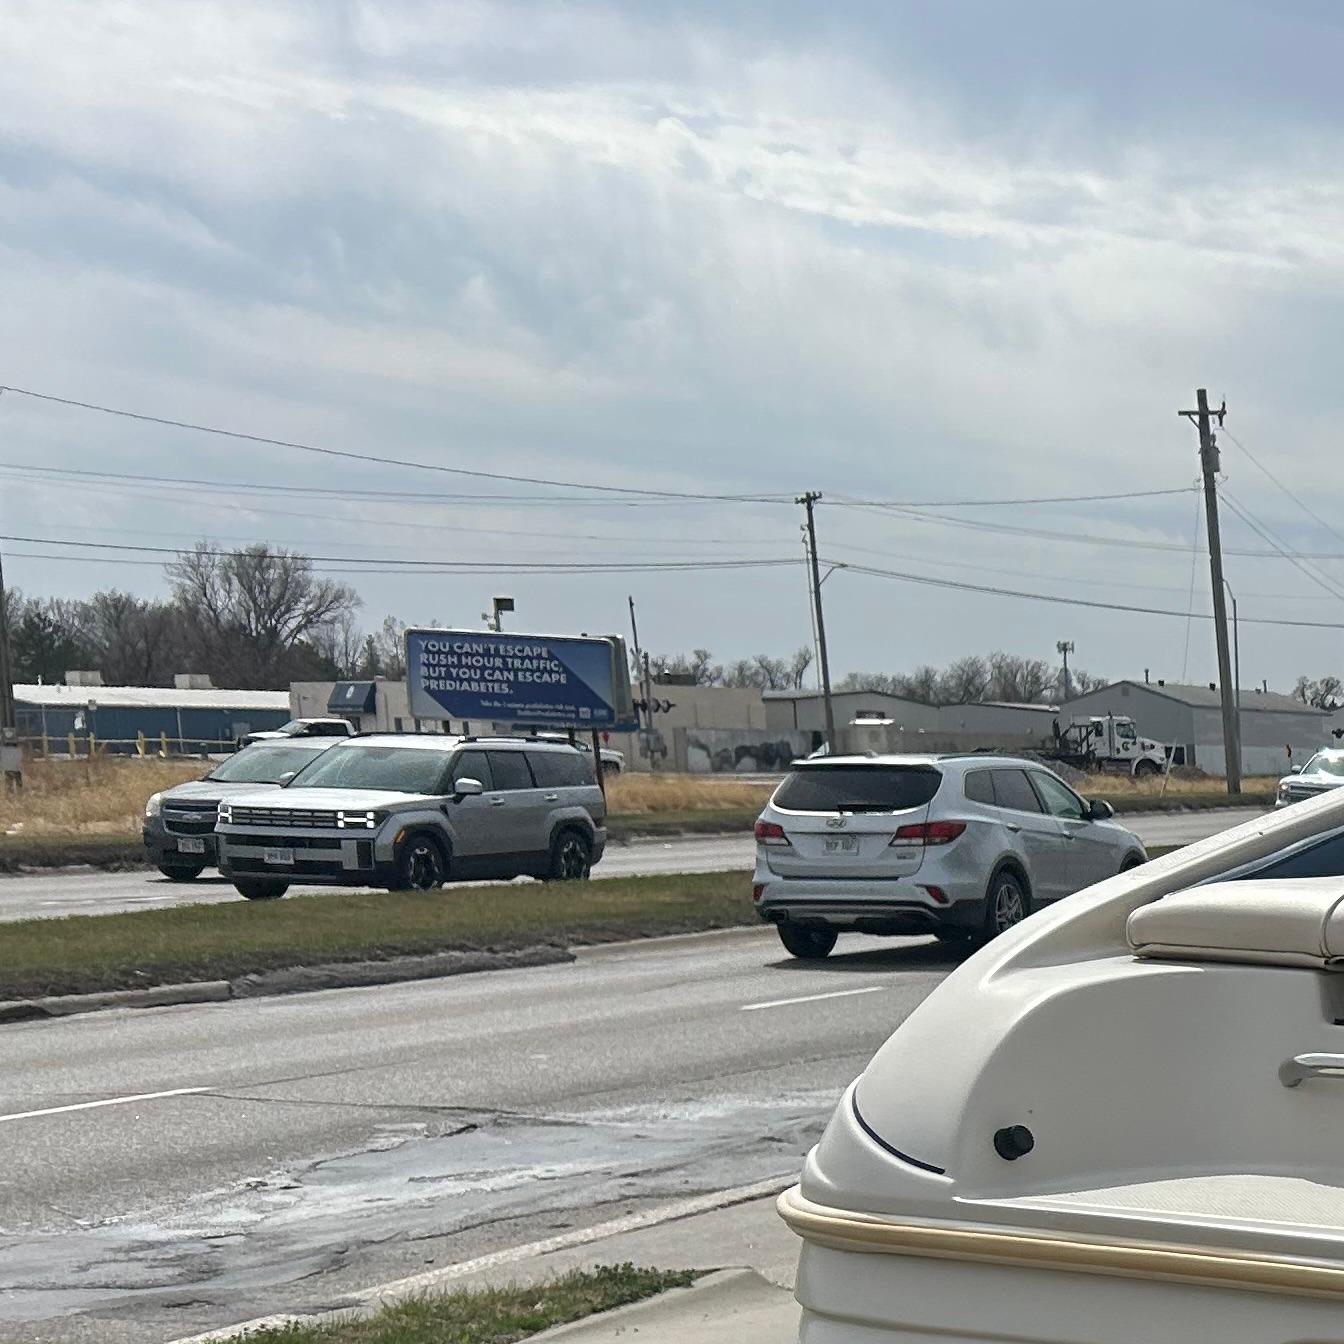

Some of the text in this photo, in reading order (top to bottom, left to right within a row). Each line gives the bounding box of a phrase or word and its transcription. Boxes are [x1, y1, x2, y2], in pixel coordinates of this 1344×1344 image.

[419, 640, 549, 658] YOU CAN'T ESCAPE
[419, 653, 563, 672] RUSH HOUR TRAFFIC,
[420, 665, 567, 684] BUT YOU CAN ESCAPE
[420, 679, 514, 694] PREDIABETES.
